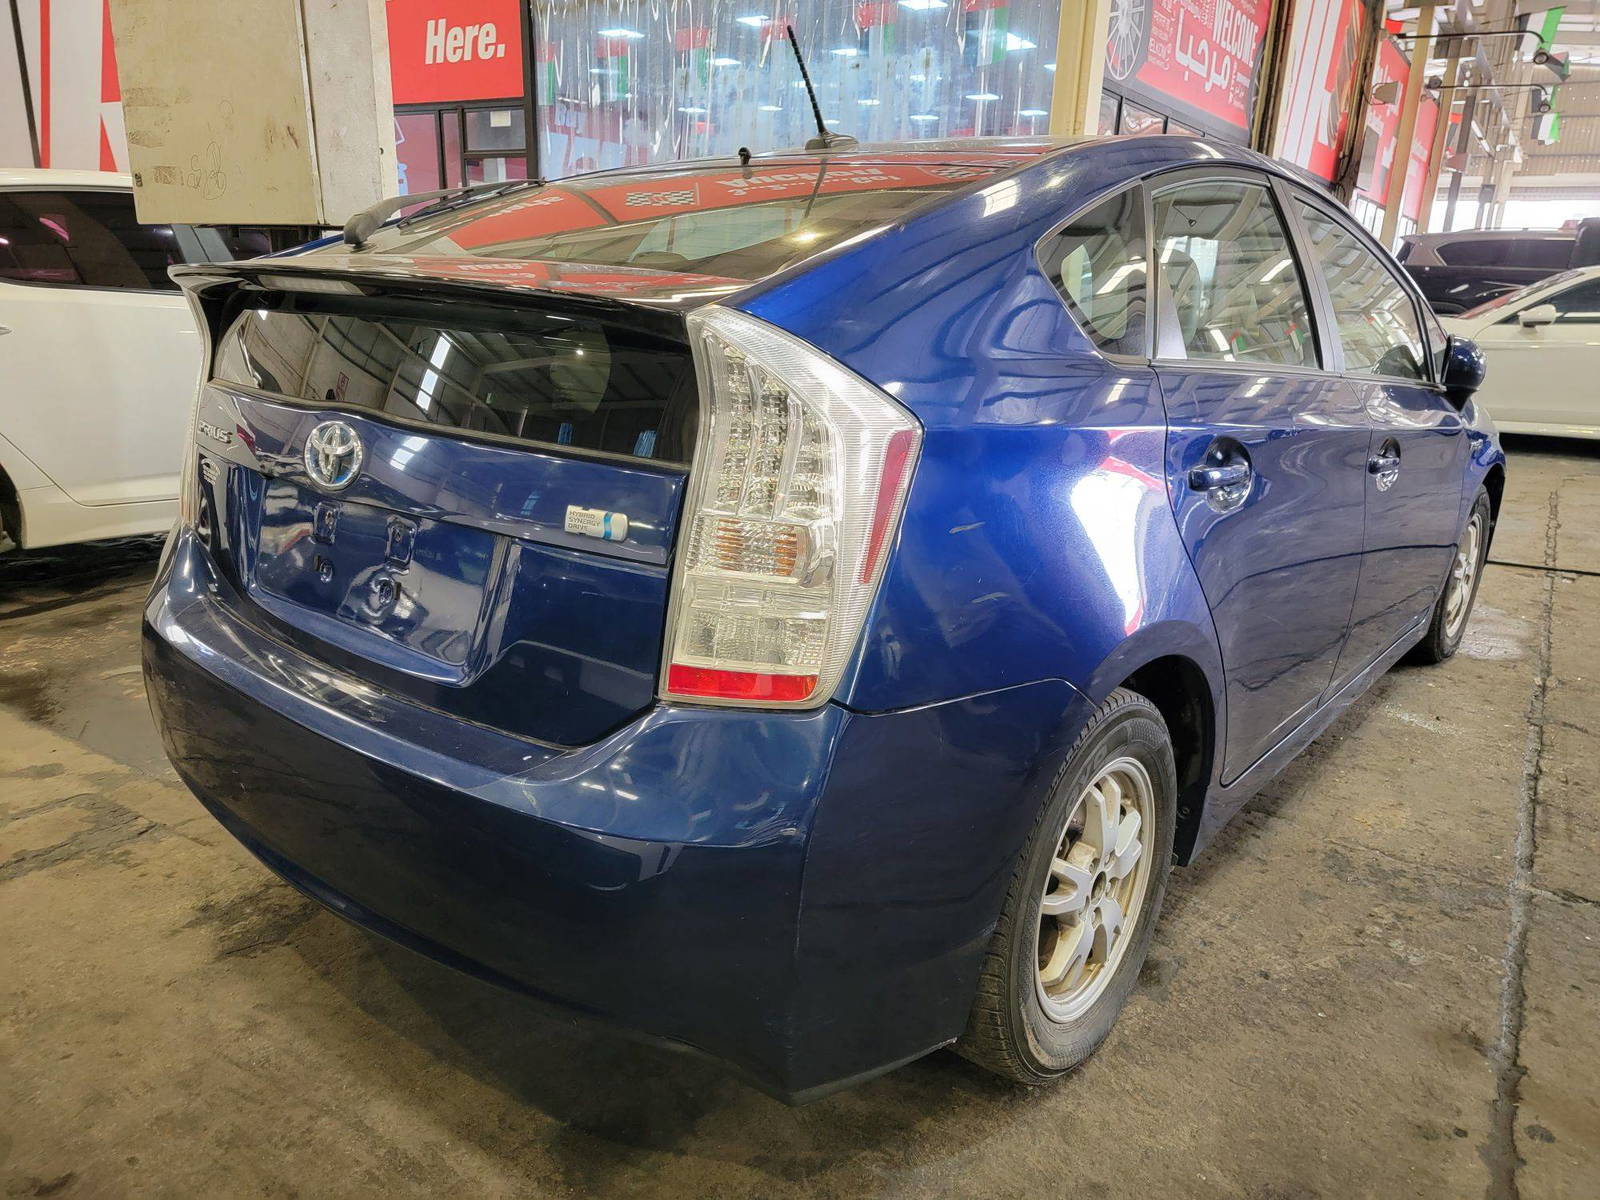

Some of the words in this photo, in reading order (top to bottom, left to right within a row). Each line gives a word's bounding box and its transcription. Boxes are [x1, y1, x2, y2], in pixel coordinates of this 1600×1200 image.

[425, 18, 506, 64] Here.
[1213, 0, 1259, 68] WELCOME
[1175, 7, 1231, 93] مرحبا
[567, 522, 589, 531] DRIVE
[568, 517, 602, 527] SYNERGY
[569, 510, 596, 520] HYBRID
